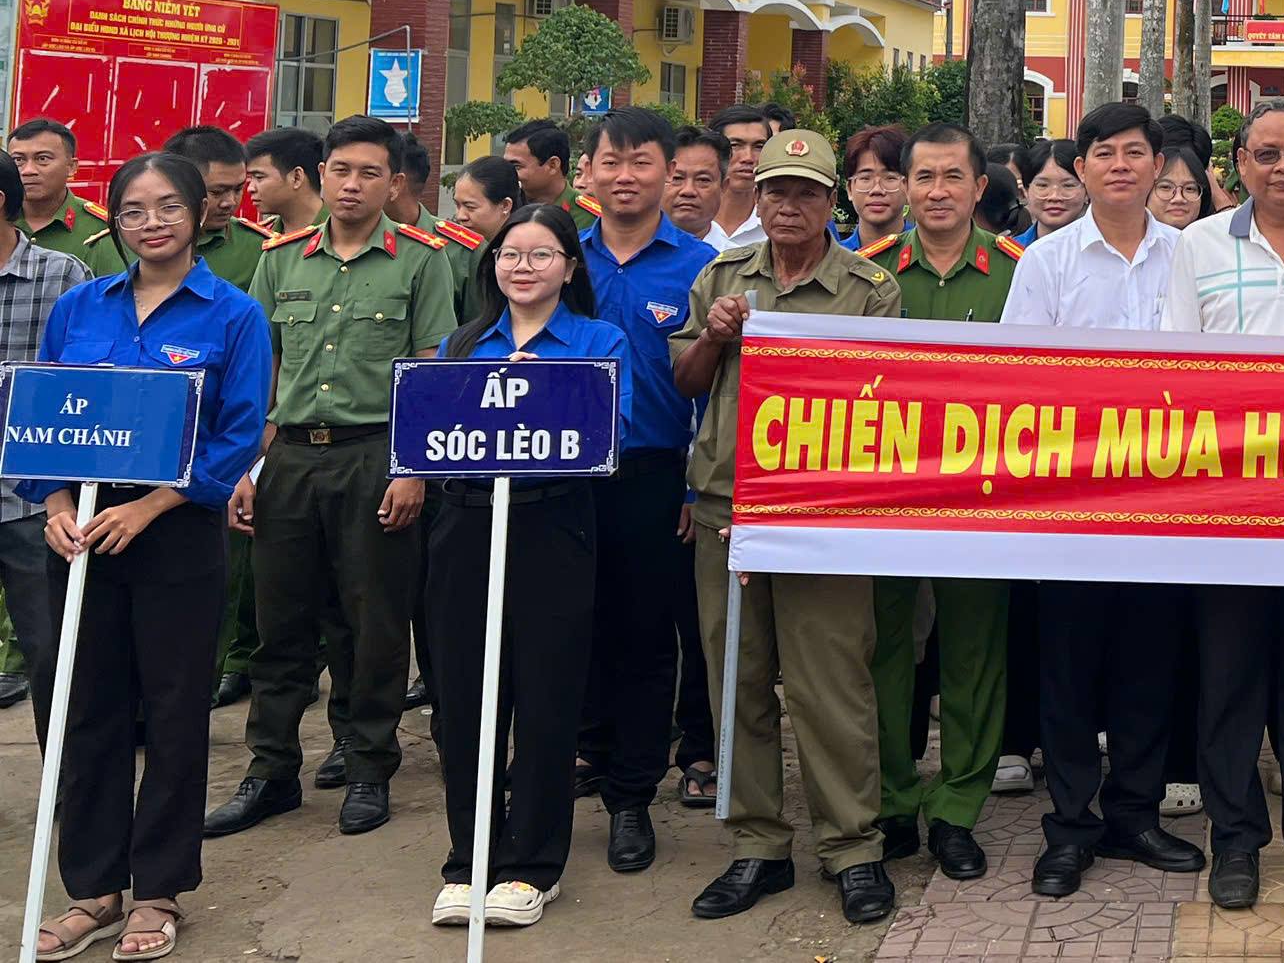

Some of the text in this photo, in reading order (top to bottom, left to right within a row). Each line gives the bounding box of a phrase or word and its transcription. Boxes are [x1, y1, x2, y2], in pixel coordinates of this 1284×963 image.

[154, 0, 181, 15] NIÊM
[183, 2, 200, 17] YẾT
[480, 368, 529, 408] ẤP
[59, 393, 88, 415] ẤP
[6, 424, 132, 447] NAM CHÁNH
[426, 423, 580, 461] SÓC LÈO B
[752, 375, 922, 474] CHIẾN
[939, 403, 1076, 495] DỊCH
[1092, 391, 1223, 478] MÙA
